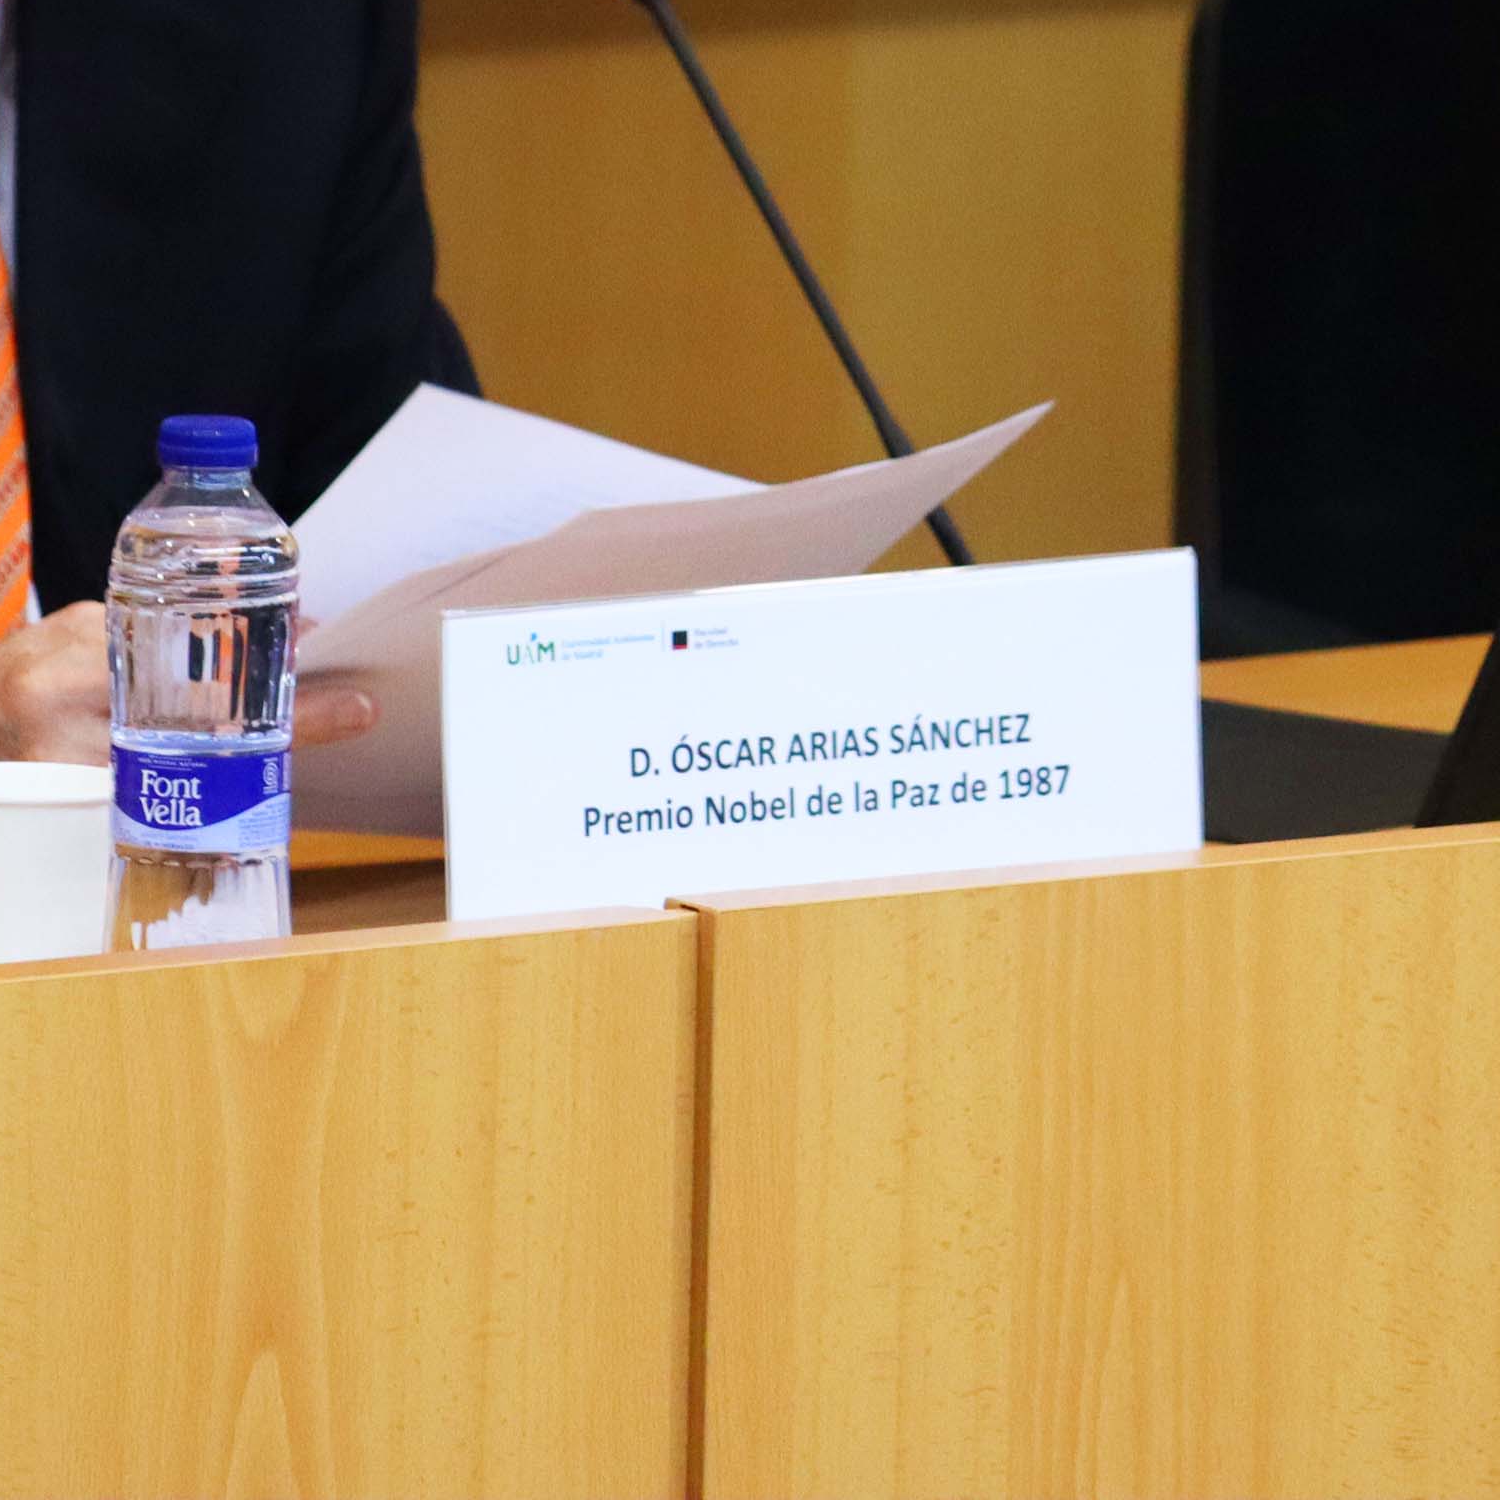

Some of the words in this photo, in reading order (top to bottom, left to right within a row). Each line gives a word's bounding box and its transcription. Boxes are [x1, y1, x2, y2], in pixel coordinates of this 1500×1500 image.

[630, 748, 660, 777] D.
[671, 734, 776, 774] ÓSCAR
[786, 727, 880, 763] ARIAS
[889, 713, 1031, 755] SÁNCHEZ
[140, 769, 202, 800] Font
[584, 801, 694, 837] Premio
[705, 787, 797, 827] Nobel
[806, 784, 843, 816] de
[855, 781, 879, 812] la
[891, 779, 940, 809] Paz
[951, 772, 988, 803] de
[999, 764, 1071, 799] 1987
[138, 796, 204, 827] Vella
